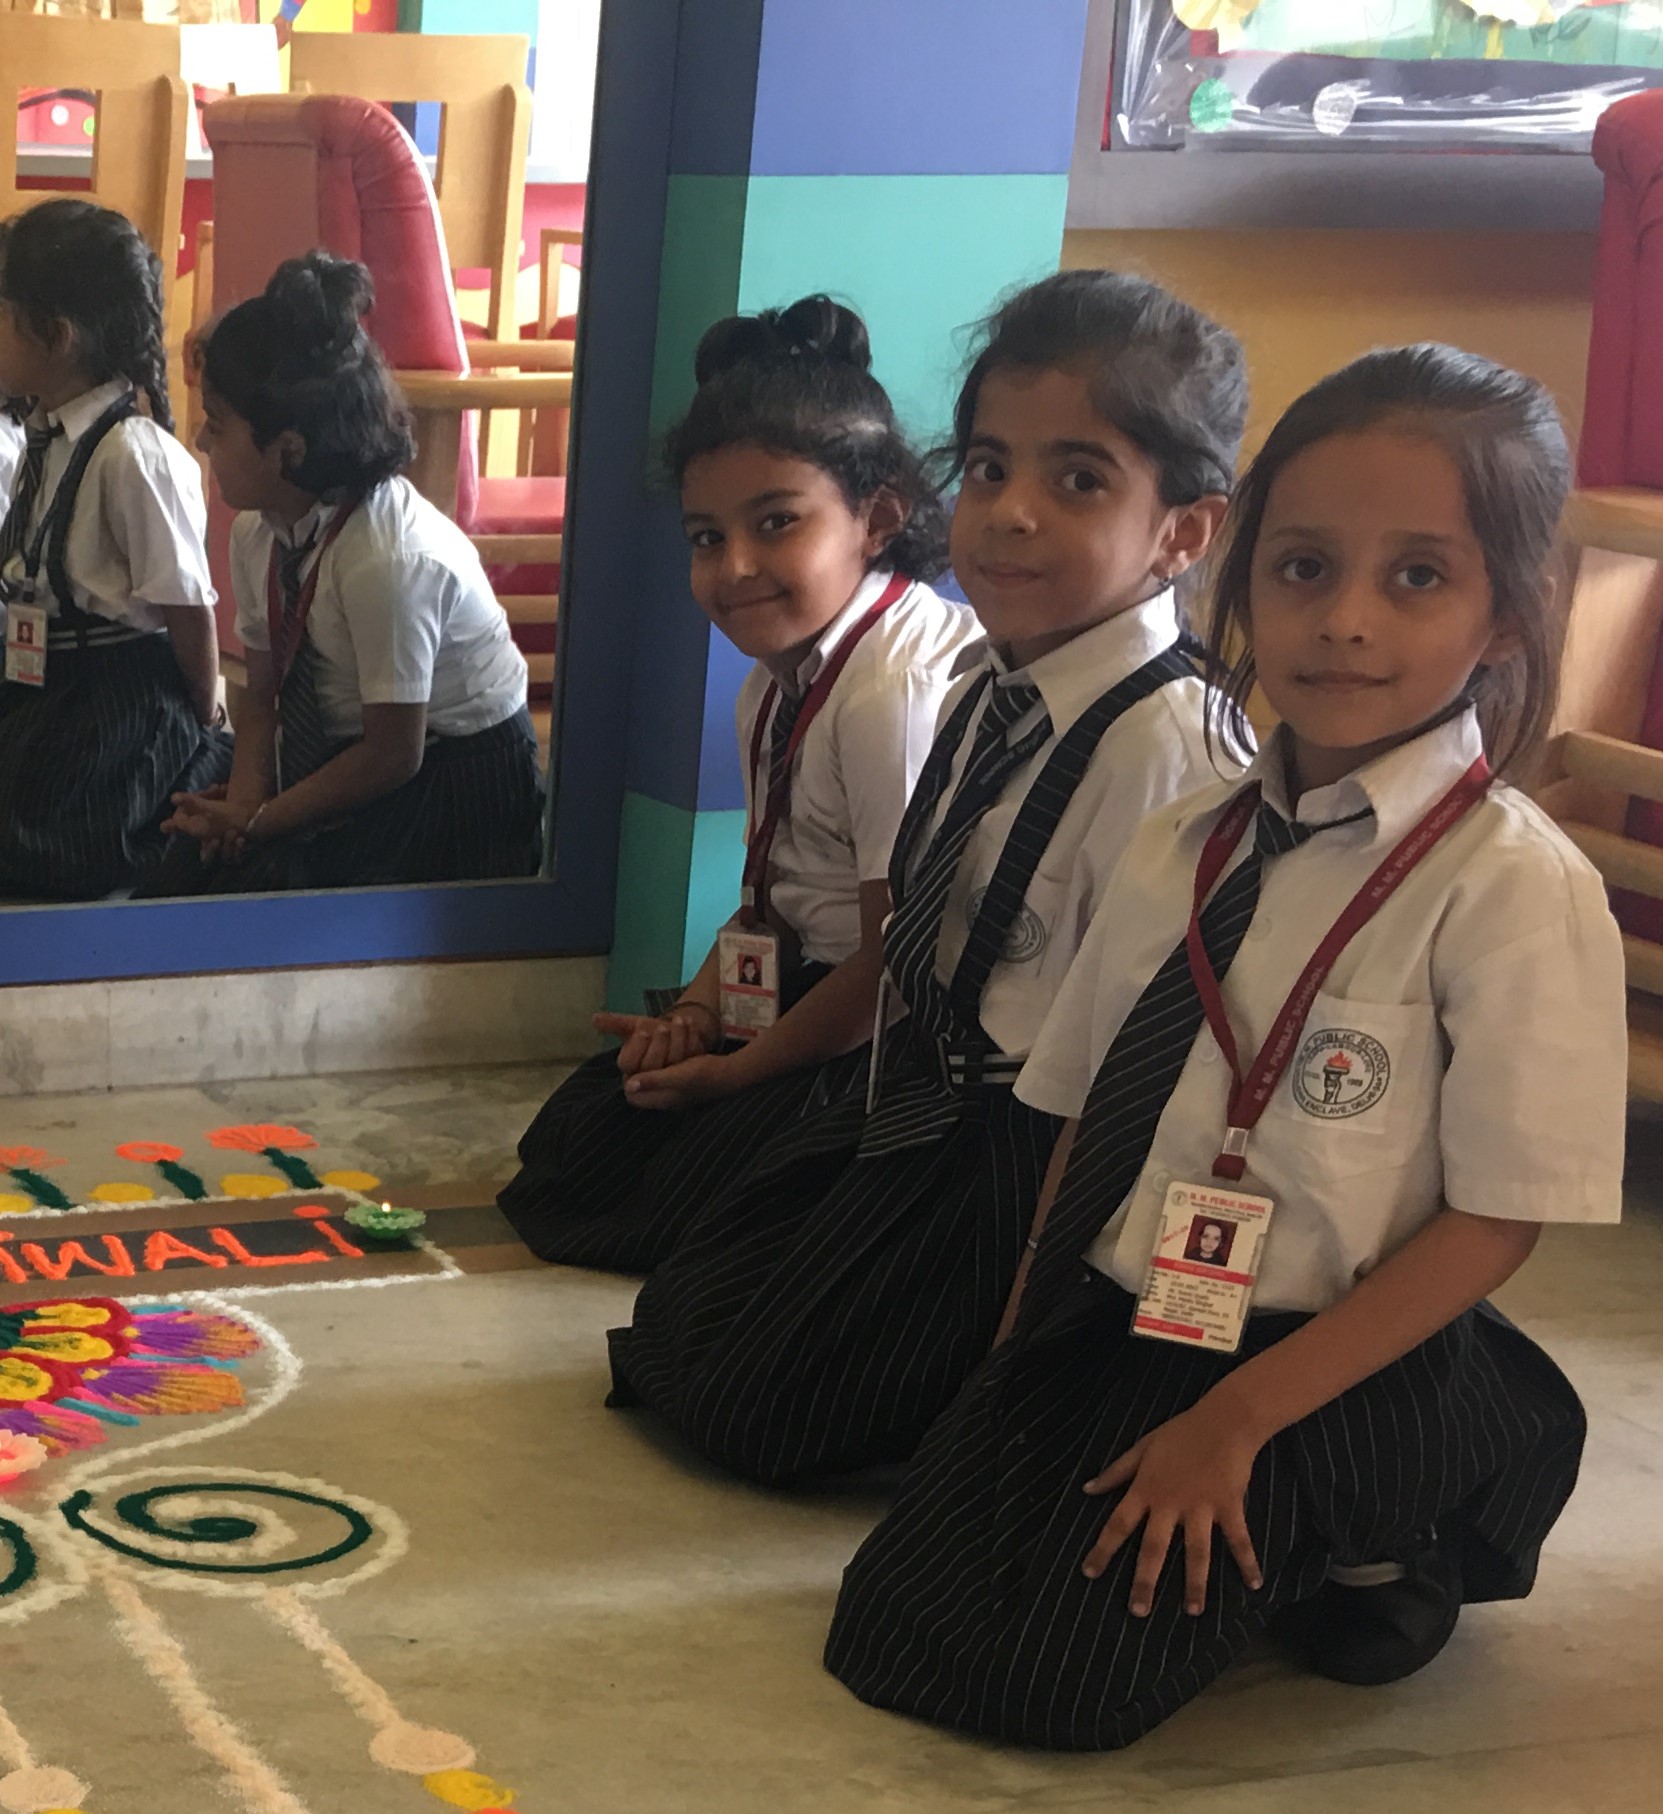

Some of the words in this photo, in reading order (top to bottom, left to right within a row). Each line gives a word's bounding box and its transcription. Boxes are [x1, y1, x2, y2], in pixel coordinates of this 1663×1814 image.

[1394, 831, 1433, 868] PUBLIC
[1269, 1020, 1296, 1066] PUBLIC
[1292, 965, 1325, 1016] SCHOOL
[1312, 1032, 1355, 1046] PUBLIC
[1357, 1037, 1387, 1077] SCHOOL
